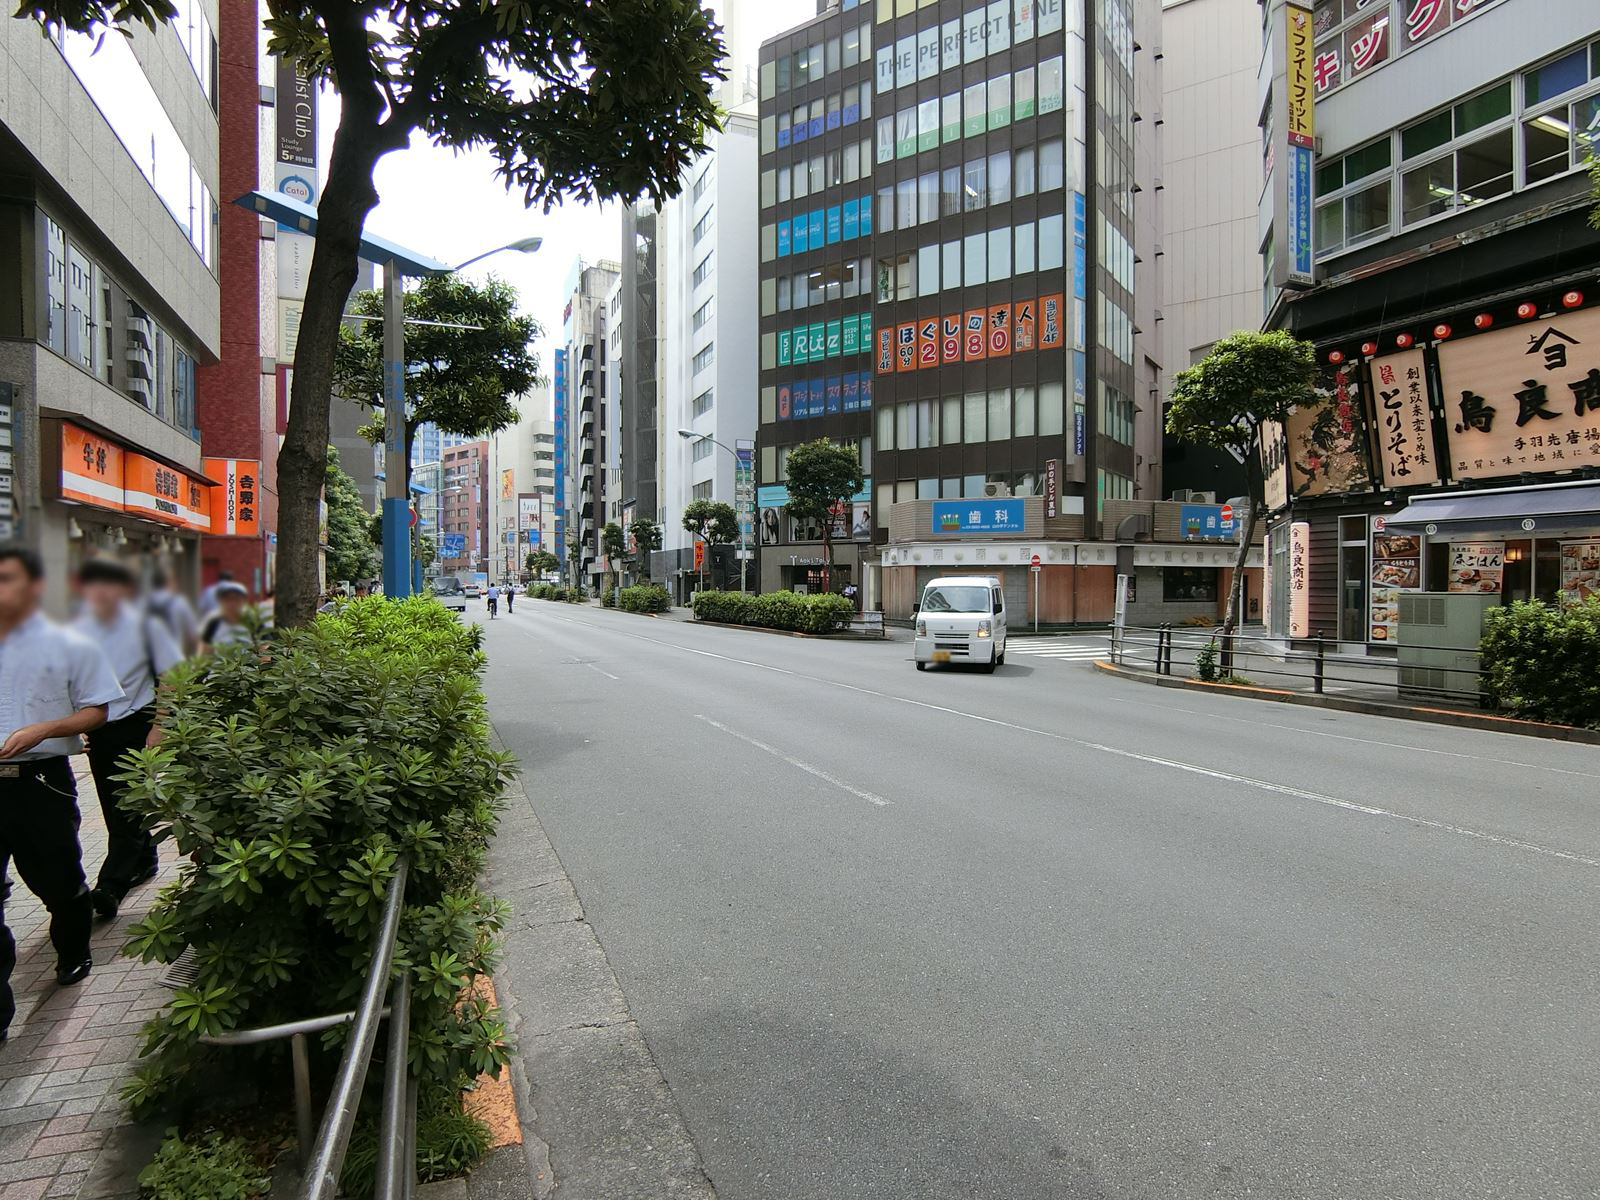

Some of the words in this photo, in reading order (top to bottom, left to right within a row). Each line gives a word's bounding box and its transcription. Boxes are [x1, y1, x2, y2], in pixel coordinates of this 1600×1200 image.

[879, 51, 911, 77] THE
[919, 16, 1002, 62] PERFECT
[1293, 33, 1307, 131] ファイトフィット
[296, 102, 311, 138] Club
[1295, 134, 1304, 143] 4F
[281, 136, 299, 145] Study
[282, 150, 294, 161] 5F
[899, 305, 1033, 345] ほぐしの達人
[1043, 300, 1057, 344] 当ビル4F
[922, 329, 1008, 364] 2980
[1380, 388, 1412, 477] とりそば
[239, 475, 254, 522] 吉野家
[968, 509, 1009, 524] 歯科
[1293, 541, 1305, 590] 鳥良商店
